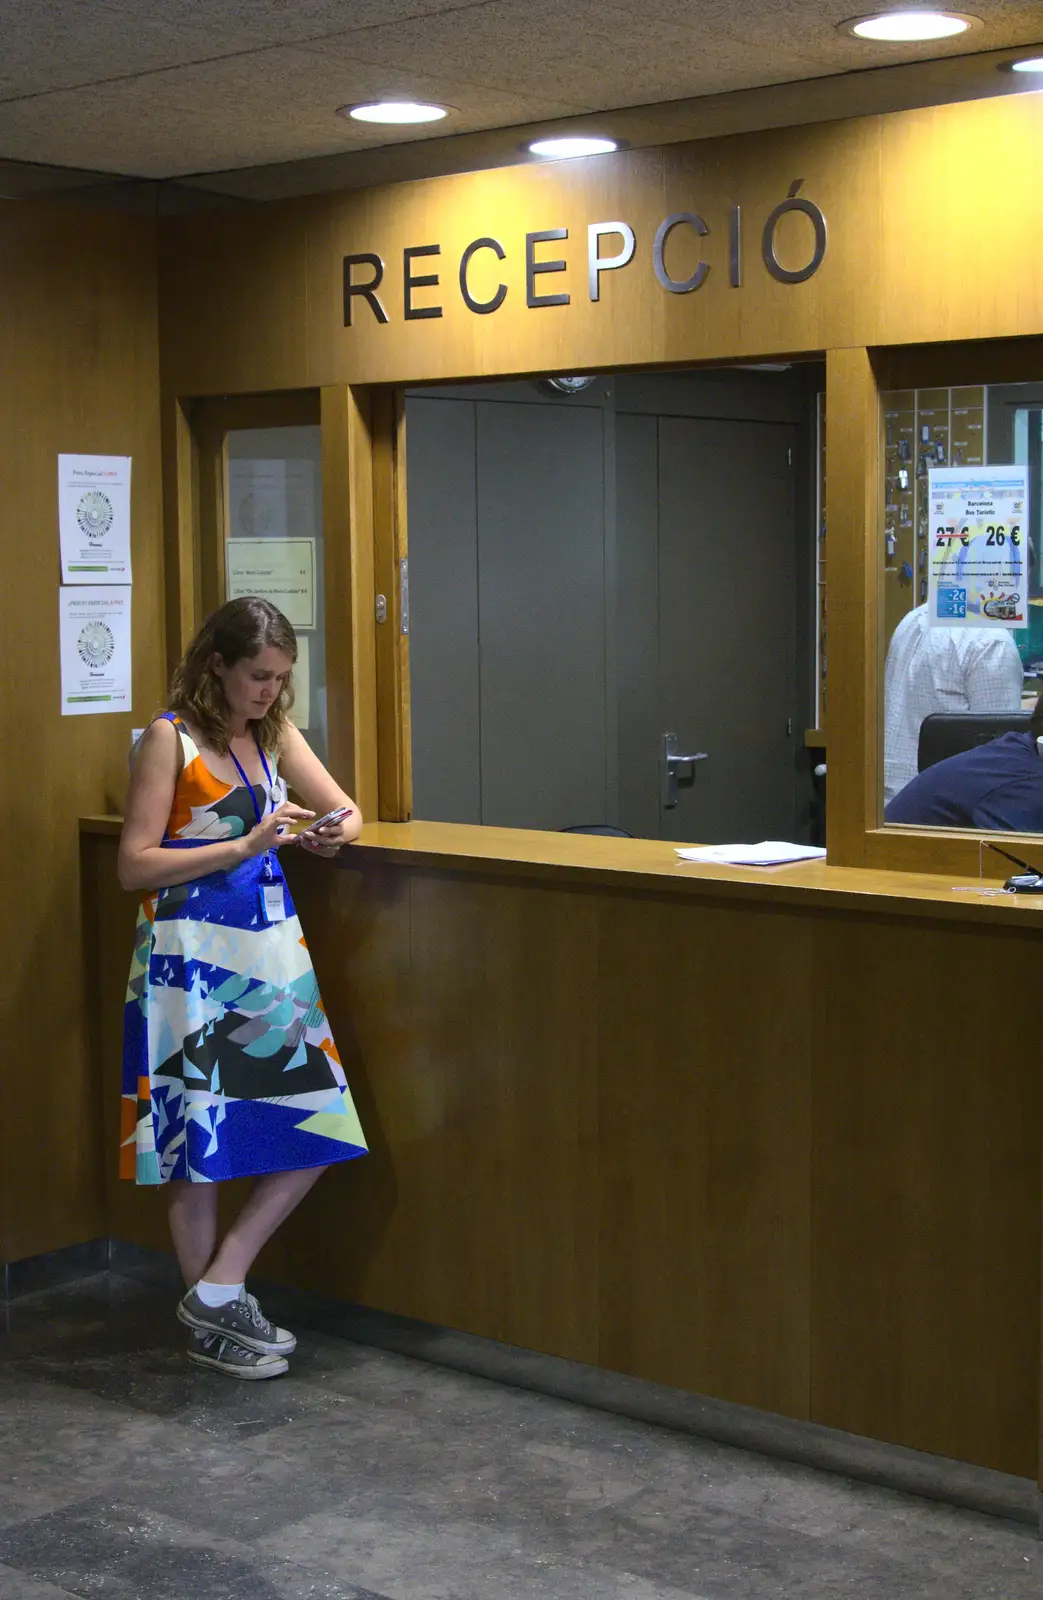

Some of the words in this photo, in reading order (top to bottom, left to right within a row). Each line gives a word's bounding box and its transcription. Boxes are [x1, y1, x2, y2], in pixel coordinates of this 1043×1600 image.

[343, 178, 827, 327] RECEPCIÓ
[936, 526, 955, 547] 27
[960, 526, 970, 547] €
[986, 525, 1006, 546] 26
[1011, 525, 1021, 546] €
